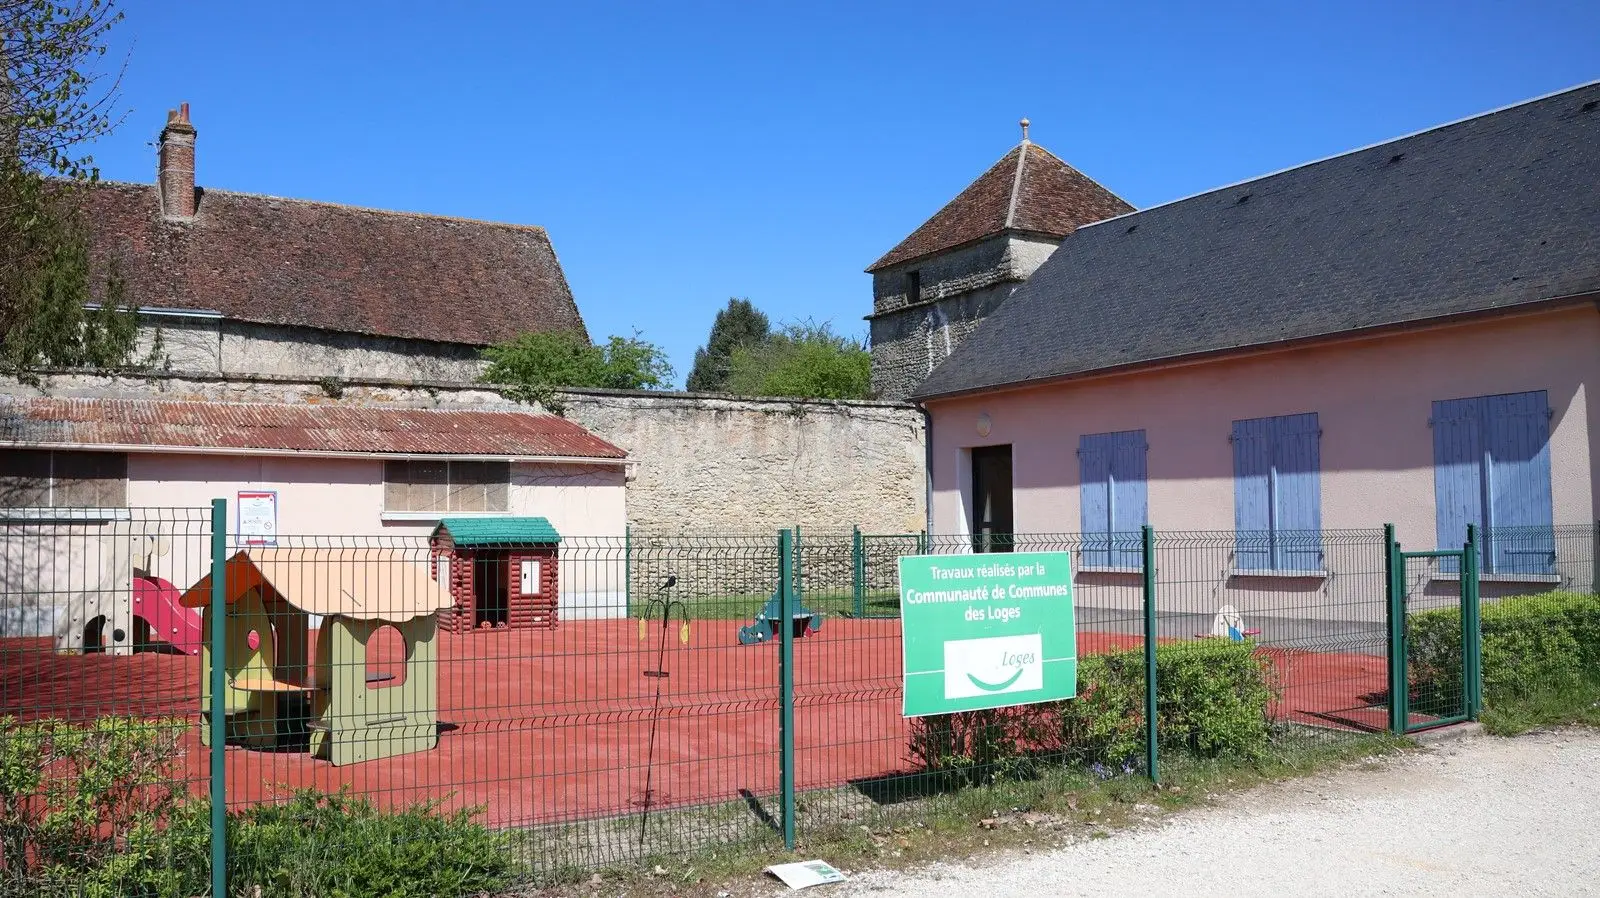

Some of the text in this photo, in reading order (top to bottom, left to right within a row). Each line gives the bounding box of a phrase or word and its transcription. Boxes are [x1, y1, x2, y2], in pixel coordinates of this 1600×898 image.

[930, 562, 1045, 579] Travaux réalisés par la
[906, 584, 1067, 604] Communauté de Communes
[964, 605, 1021, 622] des Loges
[1002, 651, 1035, 669] Loges
